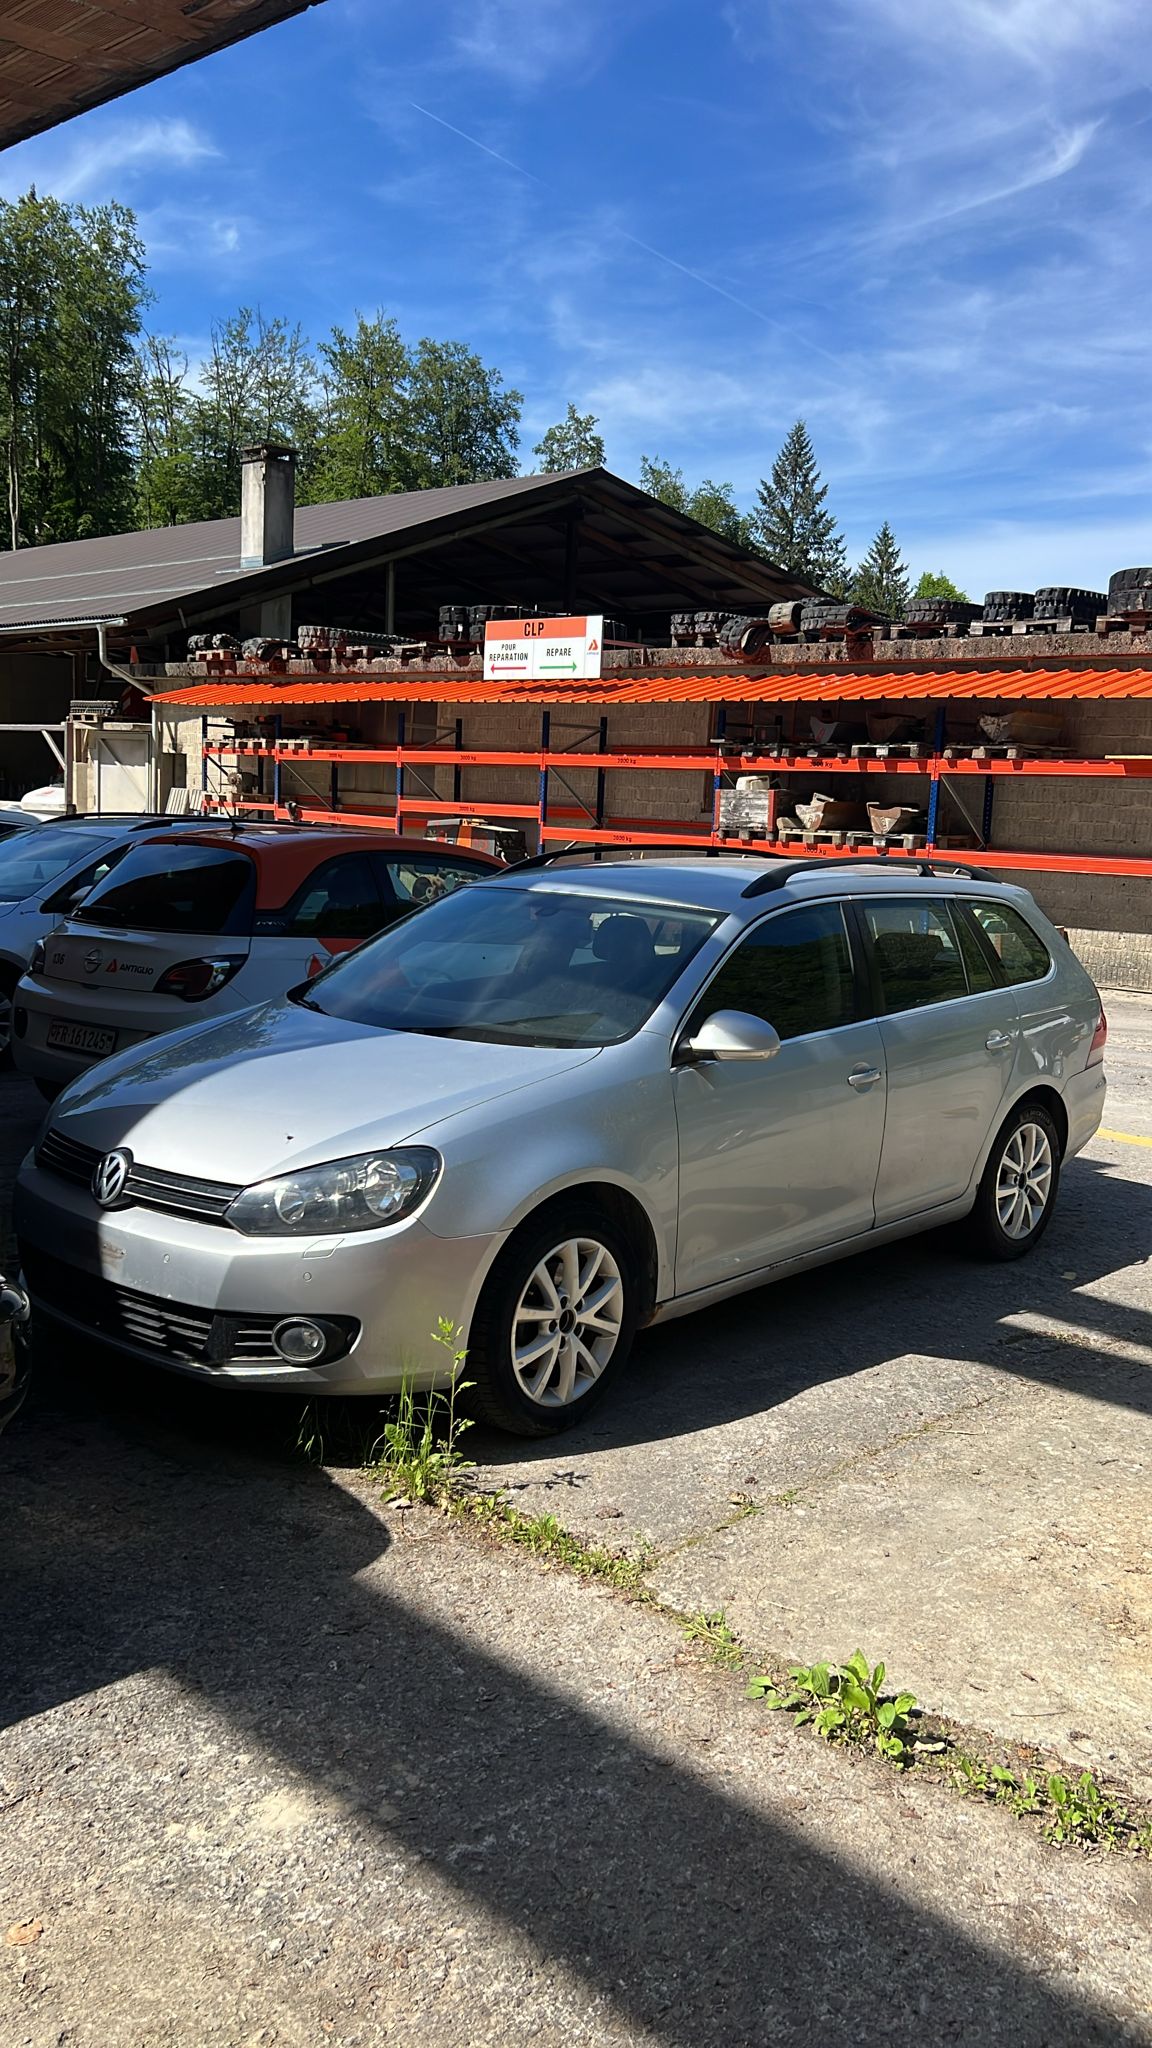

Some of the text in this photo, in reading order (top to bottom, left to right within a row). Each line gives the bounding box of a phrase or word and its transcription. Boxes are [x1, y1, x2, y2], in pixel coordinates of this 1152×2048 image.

[524, 622, 544, 637] CLP
[546, 648, 571, 656] REPARE
[489, 653, 528, 662] REPARATION
[119, 963, 154, 975] ANTIGLIO
